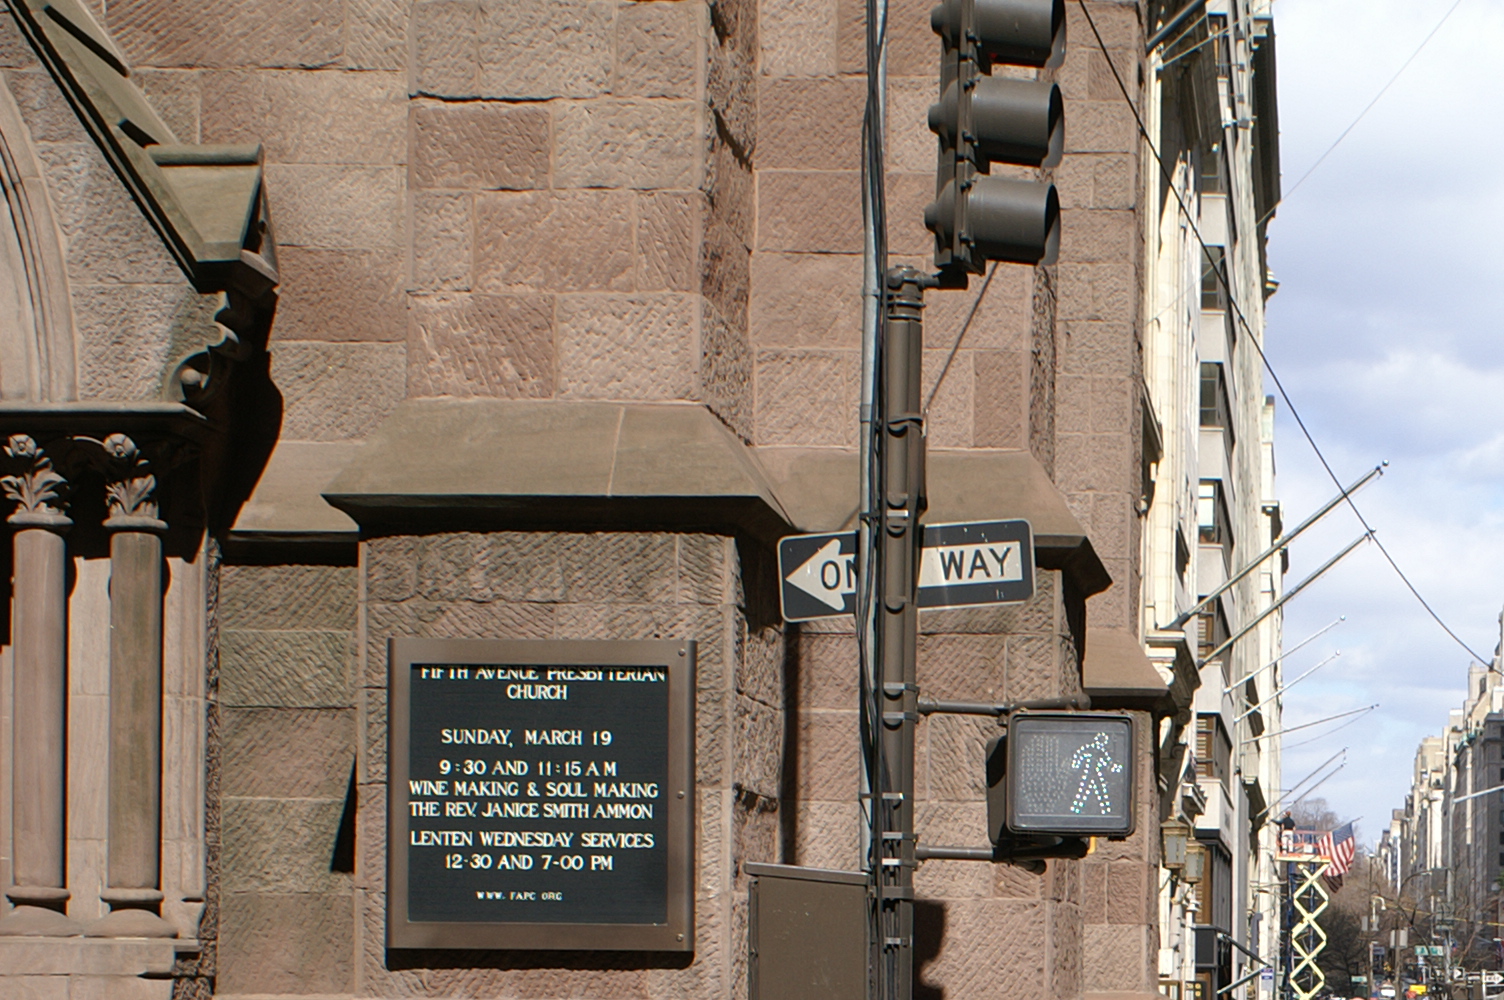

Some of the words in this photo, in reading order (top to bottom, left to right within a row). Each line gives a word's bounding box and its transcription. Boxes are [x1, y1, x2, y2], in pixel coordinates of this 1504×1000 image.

[939, 546, 1011, 580] WAY
[421, 666, 470, 680] FIFTH
[475, 666, 539, 681] AVENUE
[546, 667, 665, 682] PRESBYTERIAN
[506, 684, 568, 701] CHURCH
[441, 728, 514, 748] SUNDAY,
[524, 729, 583, 746] MARCH
[592, 730, 612, 746] 19
[491, 760, 529, 776] AND
[538, 760, 582, 777] 11:15
[408, 780, 449, 796] WINE
[454, 780, 519, 797] MAKING
[526, 781, 541, 797] &
[545, 781, 588, 798] SOUL
[593, 782, 659, 799] MAKING
[408, 801, 441, 817] THE
[481, 802, 540, 818] JANICE
[542, 802, 590, 819] SMITH
[592, 803, 653, 820] AMMON
[410, 830, 473, 847] LENTEN
[479, 831, 574, 848] WEDNESDAY
[580, 832, 655, 849] SERVICES
[497, 854, 534, 870] AND
[590, 855, 613, 871] PM
